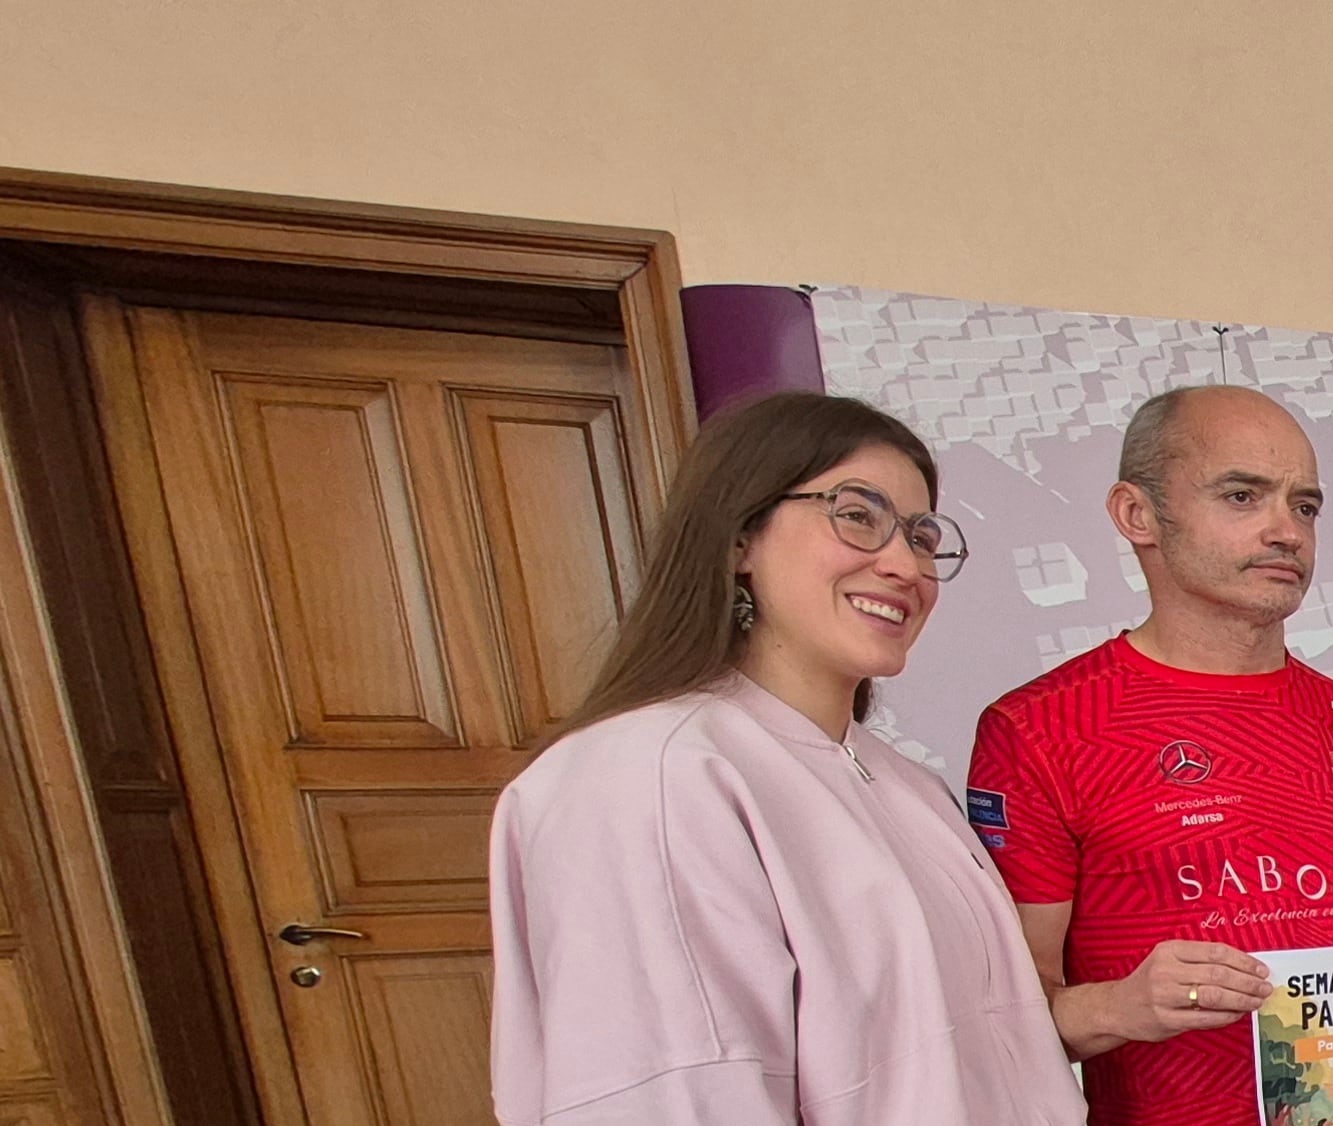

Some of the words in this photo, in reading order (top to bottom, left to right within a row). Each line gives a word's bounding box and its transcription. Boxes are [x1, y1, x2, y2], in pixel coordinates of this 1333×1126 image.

[1155, 795, 1242, 814] Mercedes-Benz
[1182, 811, 1224, 827] Adarsa
[1234, 909, 1318, 926] Excelencia
